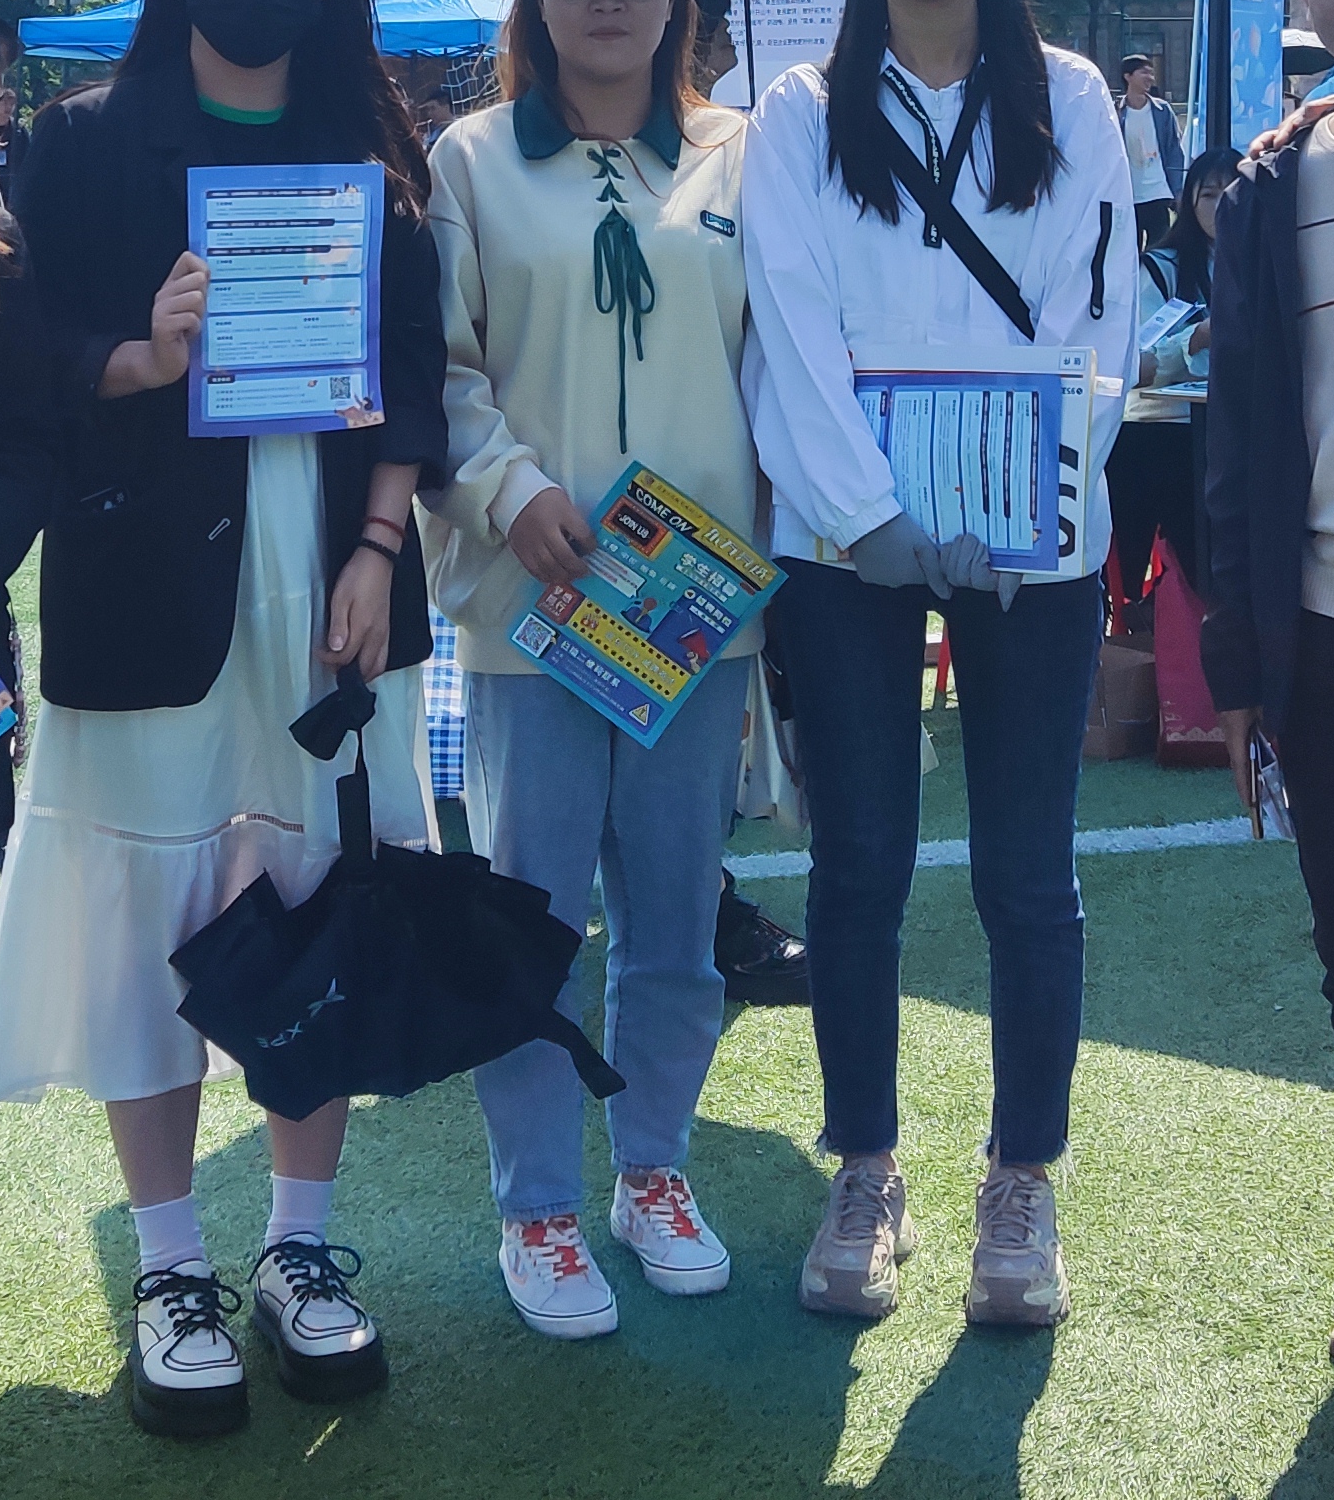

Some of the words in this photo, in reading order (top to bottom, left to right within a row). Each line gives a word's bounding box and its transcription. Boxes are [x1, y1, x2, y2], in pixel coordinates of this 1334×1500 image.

[618, 512, 638, 531] JOIN
[633, 487, 670, 518] COME
[668, 514, 692, 532] ON
